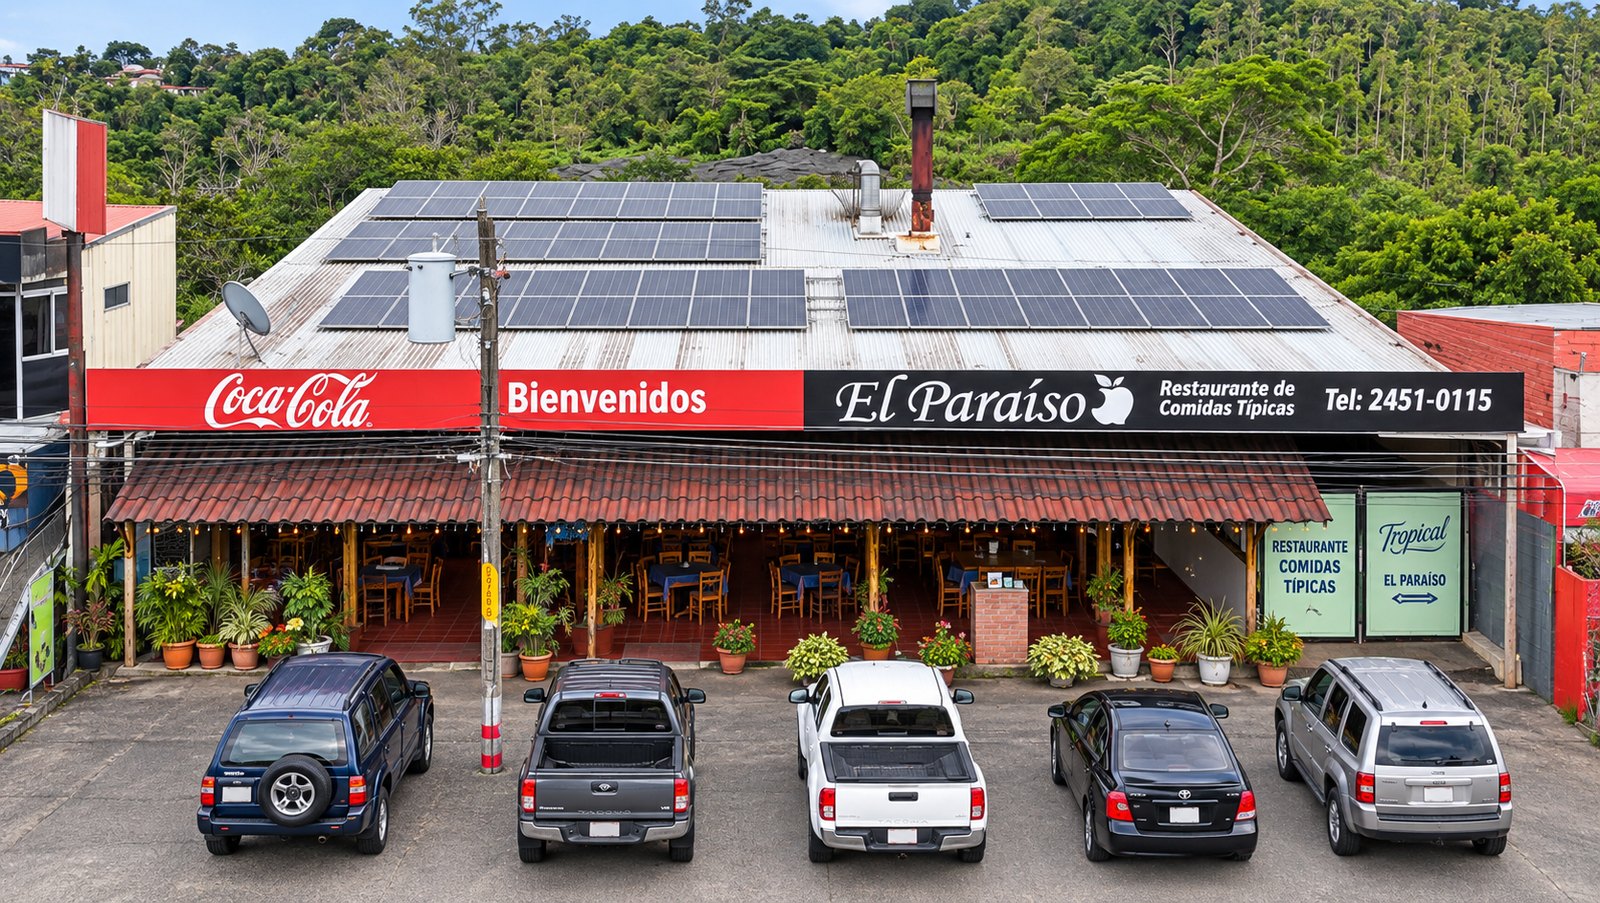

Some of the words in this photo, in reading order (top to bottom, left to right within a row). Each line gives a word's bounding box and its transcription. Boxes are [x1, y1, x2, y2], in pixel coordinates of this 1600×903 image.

[508, 381, 707, 414] Bienvenidos
[835, 374, 908, 423] El
[908, 378, 1087, 423] Paraíso
[1159, 380, 1269, 397] Restaurante
[1273, 380, 1296, 397] de
[205, 372, 378, 429] Coca-Cola
[1159, 399, 1233, 416] Comidas
[1236, 399, 1295, 420] Típicas
[1325, 388, 1363, 411] Tel:
[1368, 388, 1493, 412] 2451-0115
[1379, 515, 1451, 555] Tropical
[1272, 540, 1349, 553] RESTAURANTE
[1279, 559, 1341, 574] COMIDAS
[1284, 577, 1336, 594] TÍPICAS
[1384, 574, 1397, 587] EL
[1400, 571, 1447, 587] PARAÍSO
